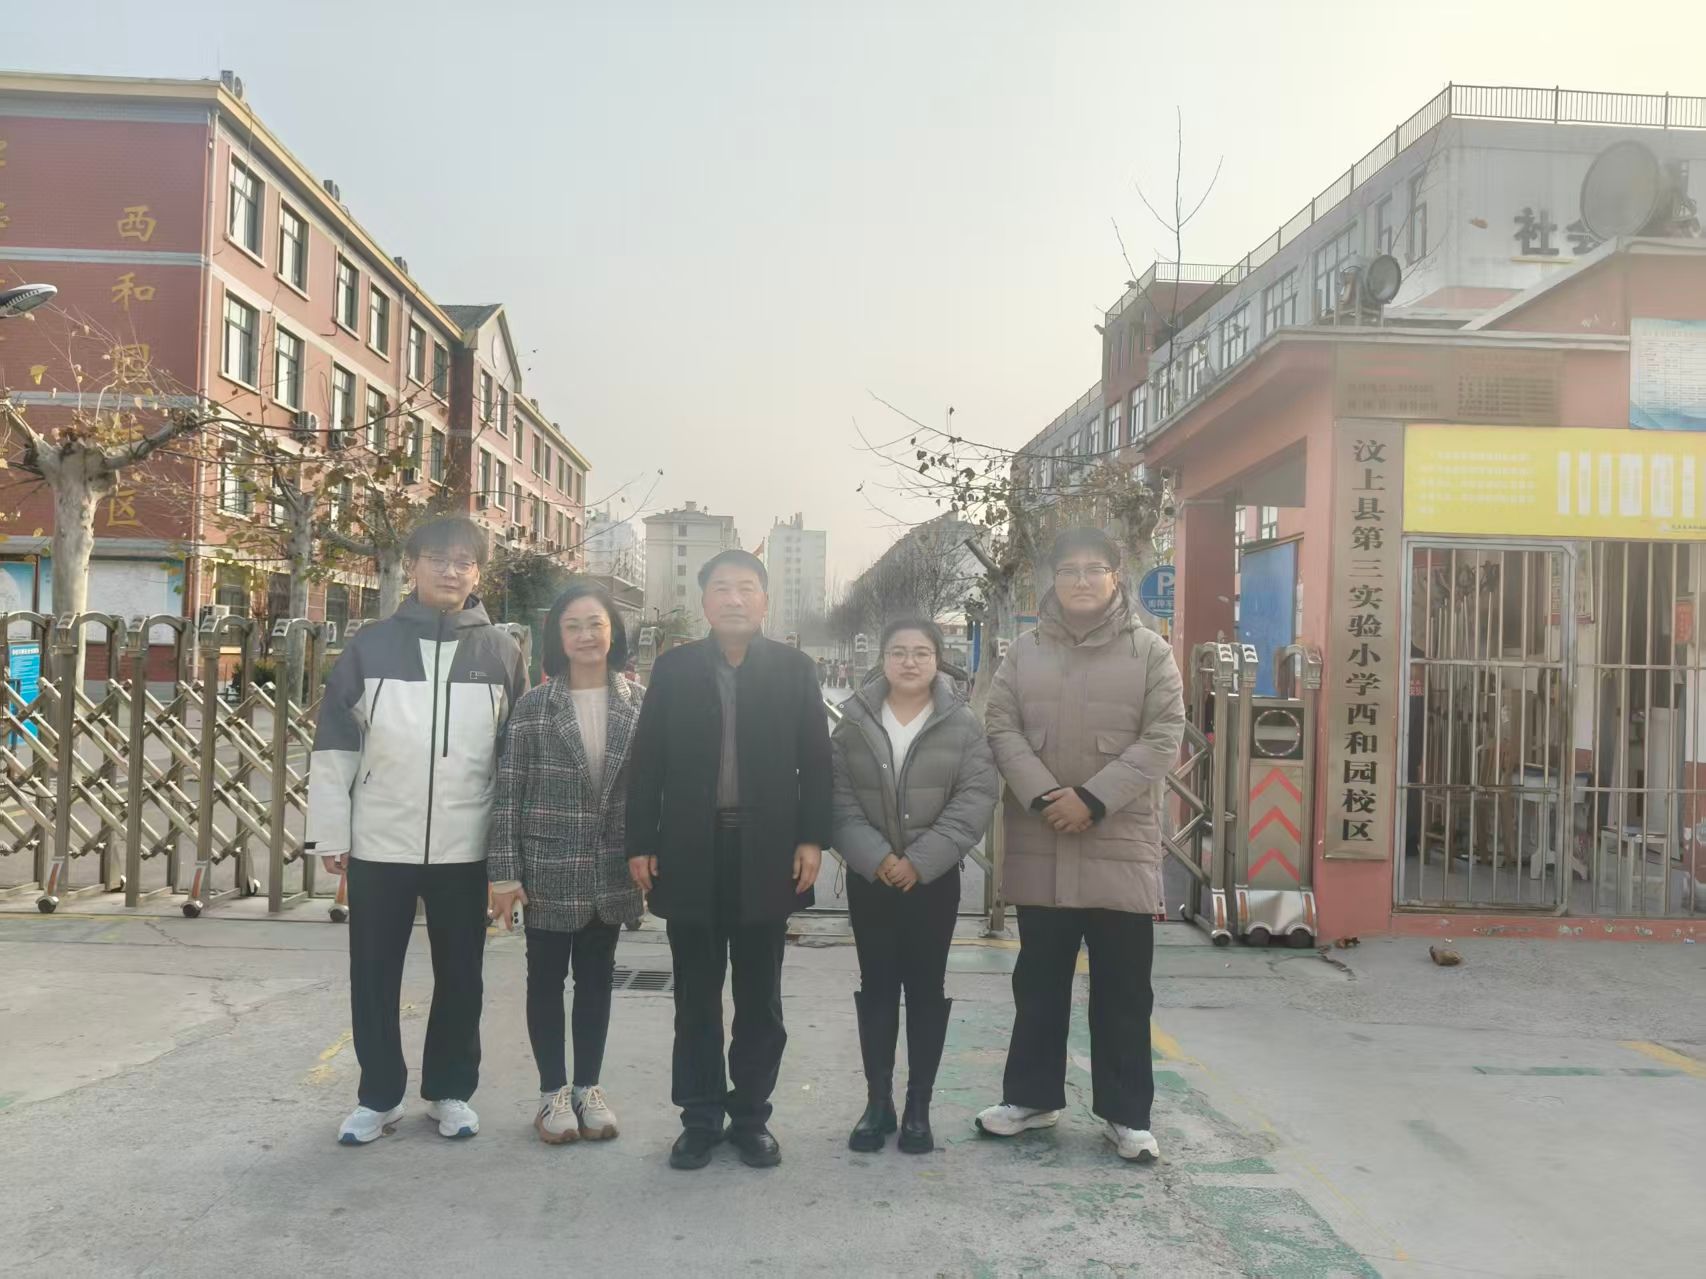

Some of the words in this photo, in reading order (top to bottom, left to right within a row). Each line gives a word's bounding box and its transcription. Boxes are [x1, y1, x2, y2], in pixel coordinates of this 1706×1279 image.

[107, 205, 157, 526] 西和园区
[1157, 571, 1175, 596] P
[1341, 439, 1387, 842] 汶上县第三实验小学西和园校区
